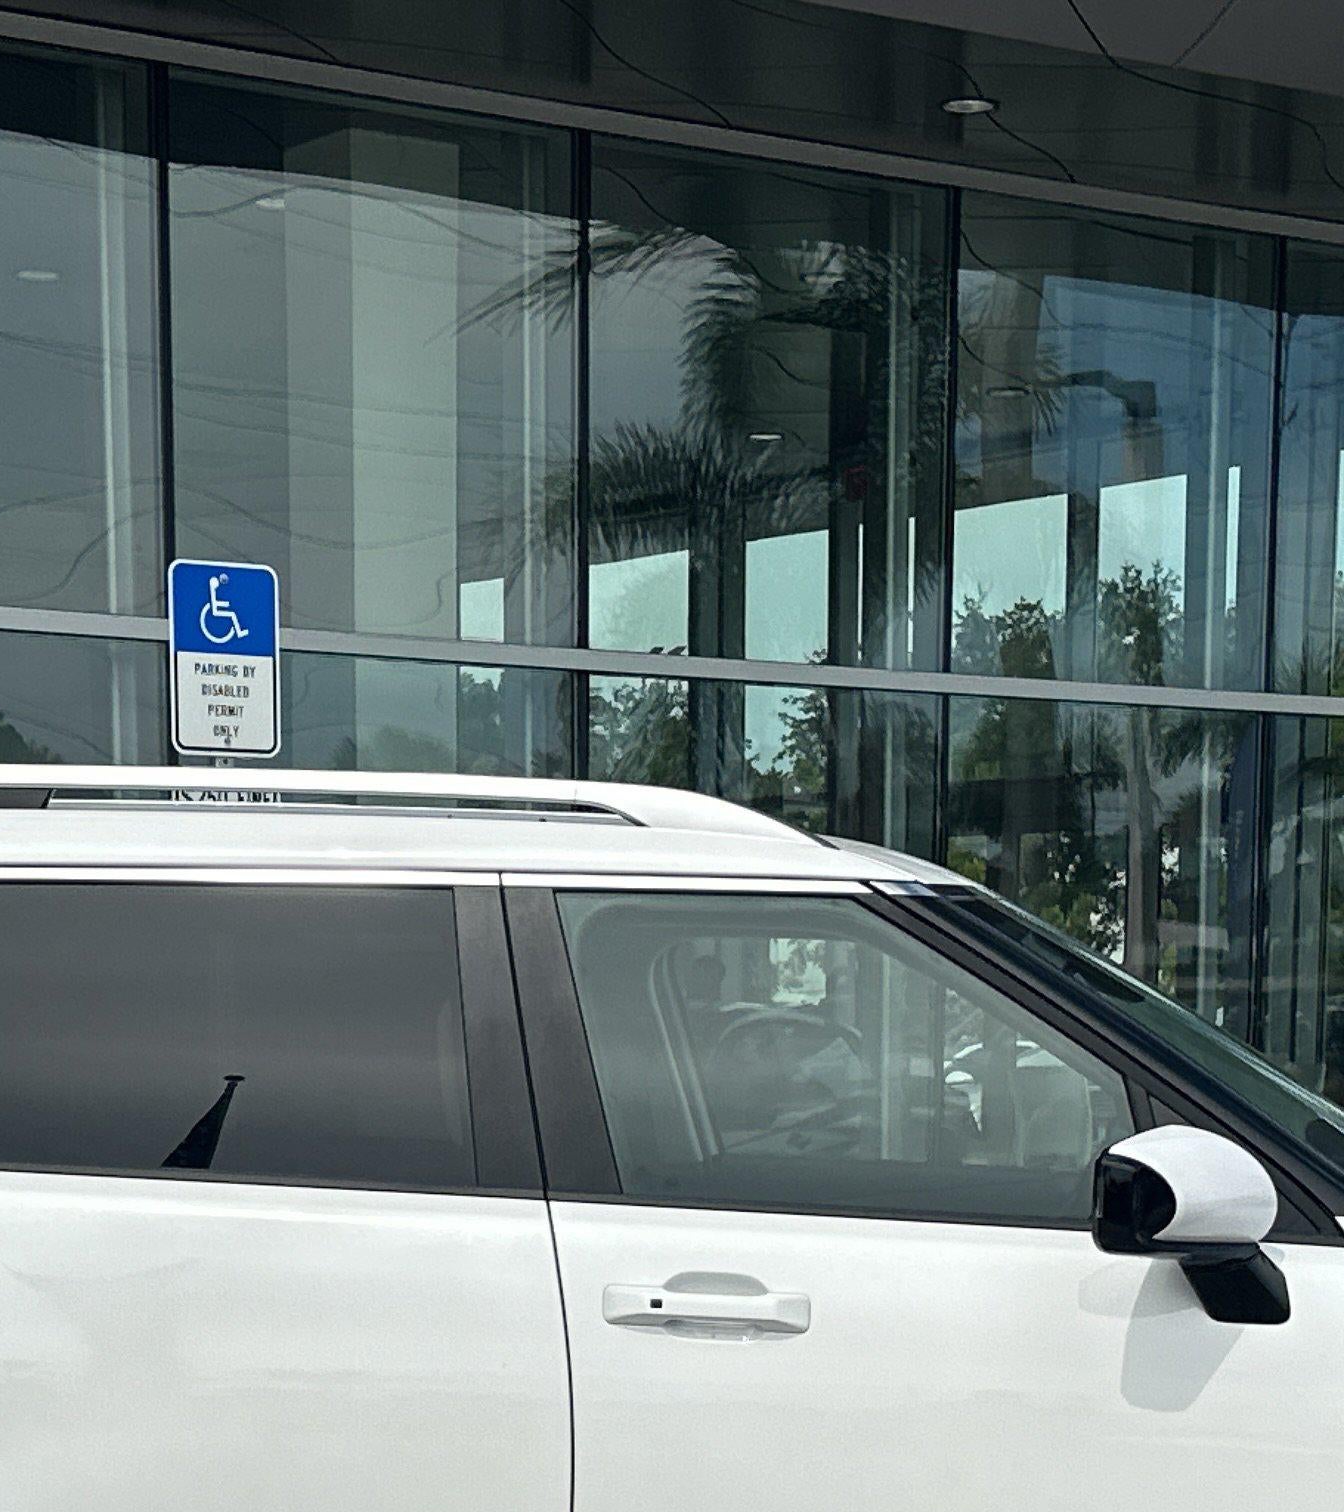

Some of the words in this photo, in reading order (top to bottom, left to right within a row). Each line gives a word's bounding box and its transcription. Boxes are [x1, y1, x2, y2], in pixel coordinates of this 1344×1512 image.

[194, 662, 238, 677] PARKING
[201, 683, 249, 698] DISABLED
[208, 704, 244, 718] PERMIT
[213, 725, 240, 738] ONLY
